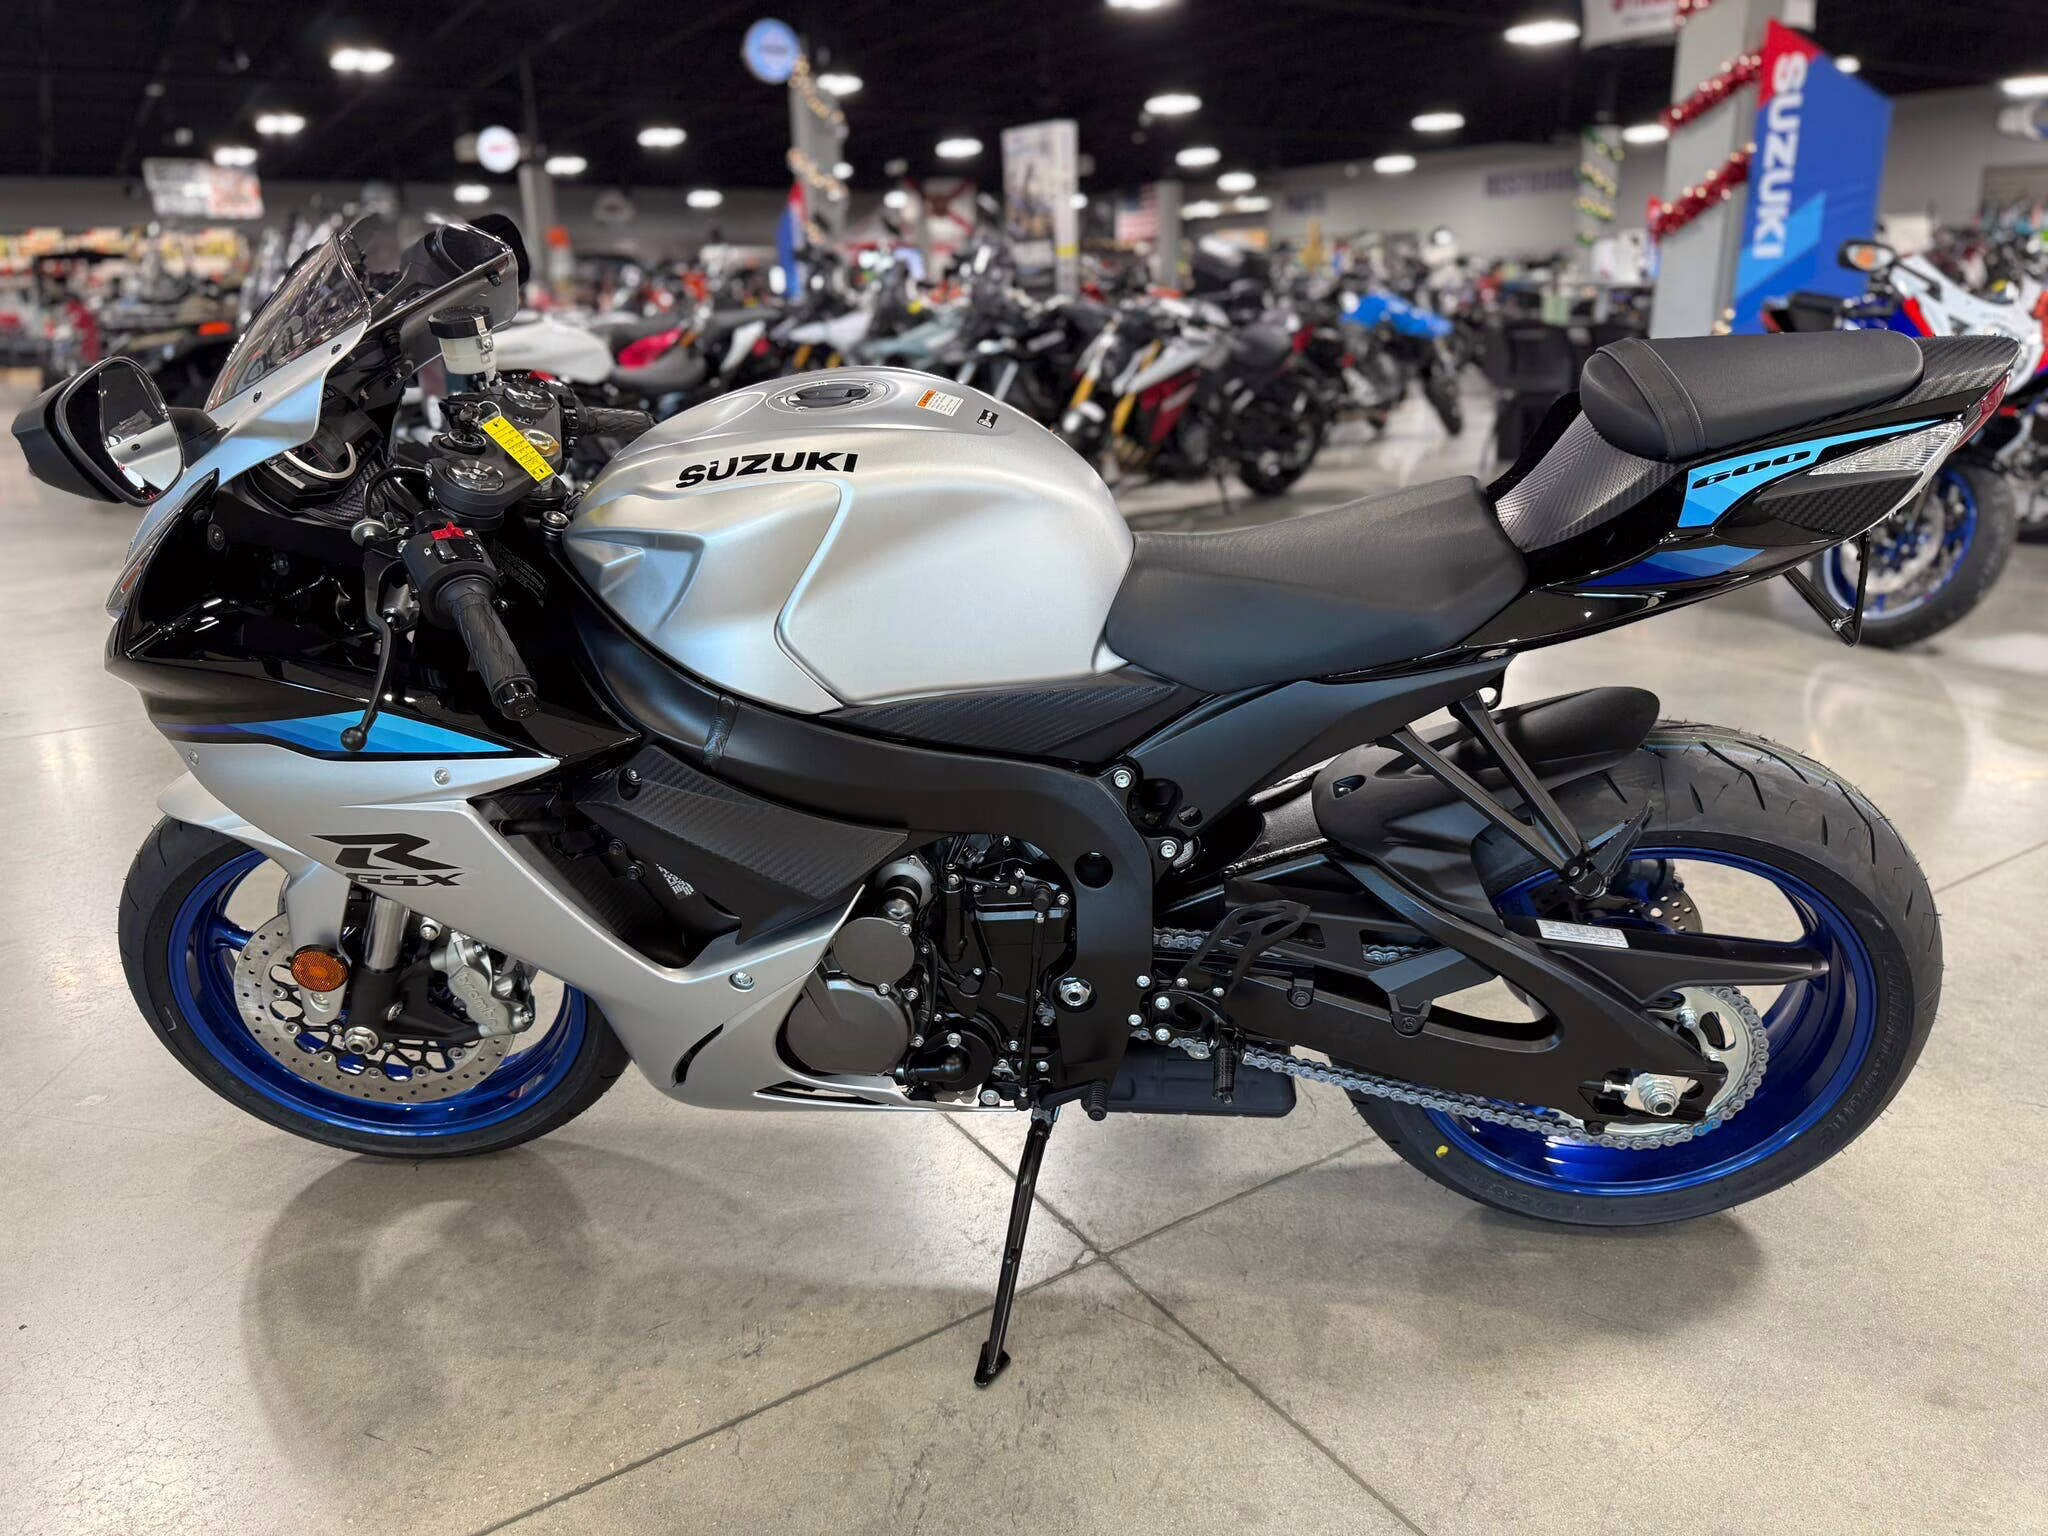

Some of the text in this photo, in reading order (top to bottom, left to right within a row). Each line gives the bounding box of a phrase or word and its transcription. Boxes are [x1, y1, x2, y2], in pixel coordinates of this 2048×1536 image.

[1753, 51, 1808, 260] SUZUKI
[675, 452, 858, 489] SUZUKI
[1692, 451, 1811, 489] 600
[310, 833, 462, 870] R
[345, 872, 465, 887] GSX
[453, 971, 499, 1028] brembo
